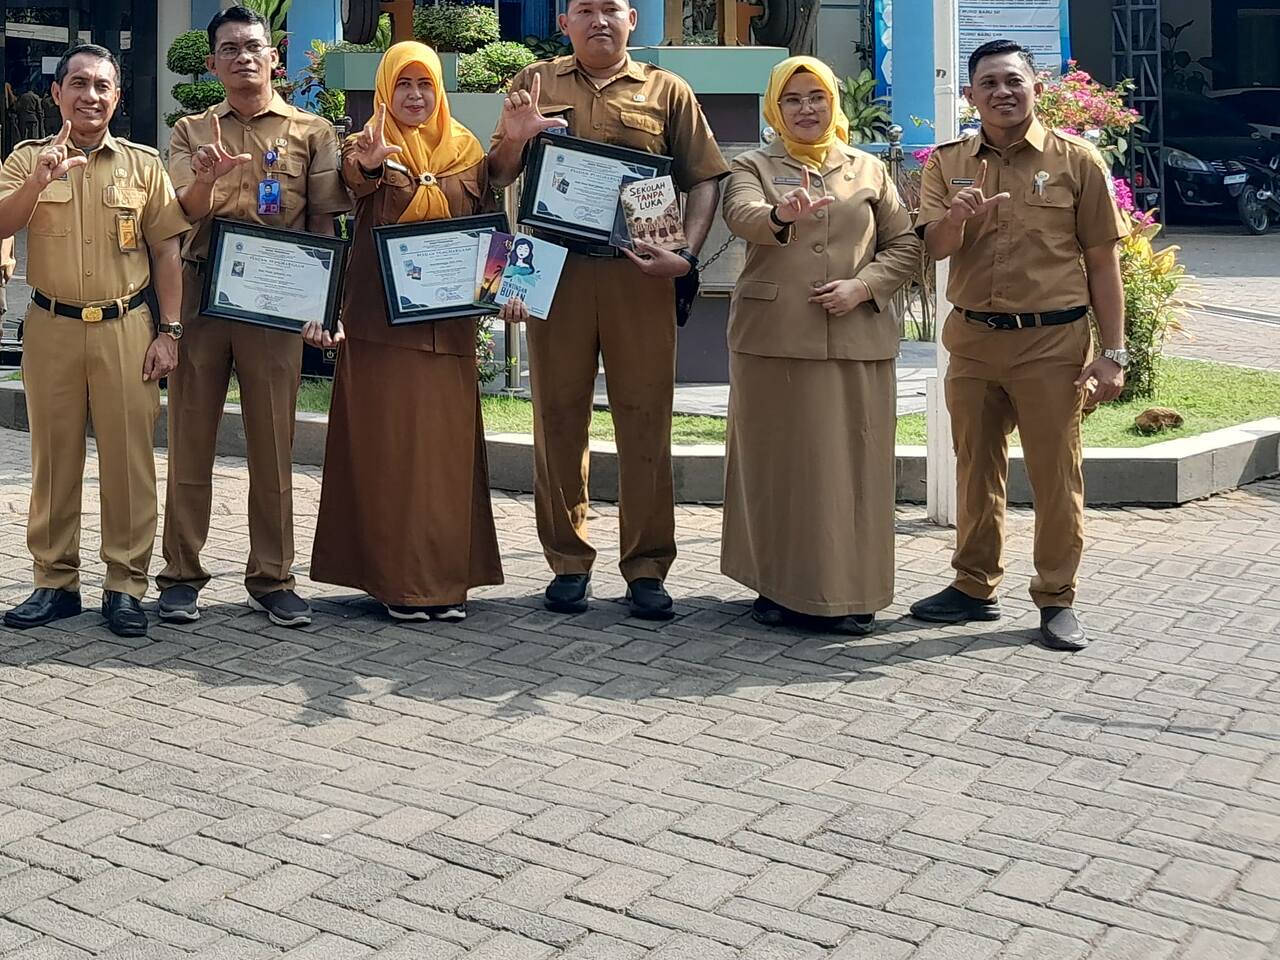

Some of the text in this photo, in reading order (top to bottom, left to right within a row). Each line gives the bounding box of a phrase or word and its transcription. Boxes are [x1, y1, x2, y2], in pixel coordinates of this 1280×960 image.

[629, 182, 666, 197] SEKOLAH
[635, 190, 664, 203] TANPA
[639, 198, 663, 210] LUKA
